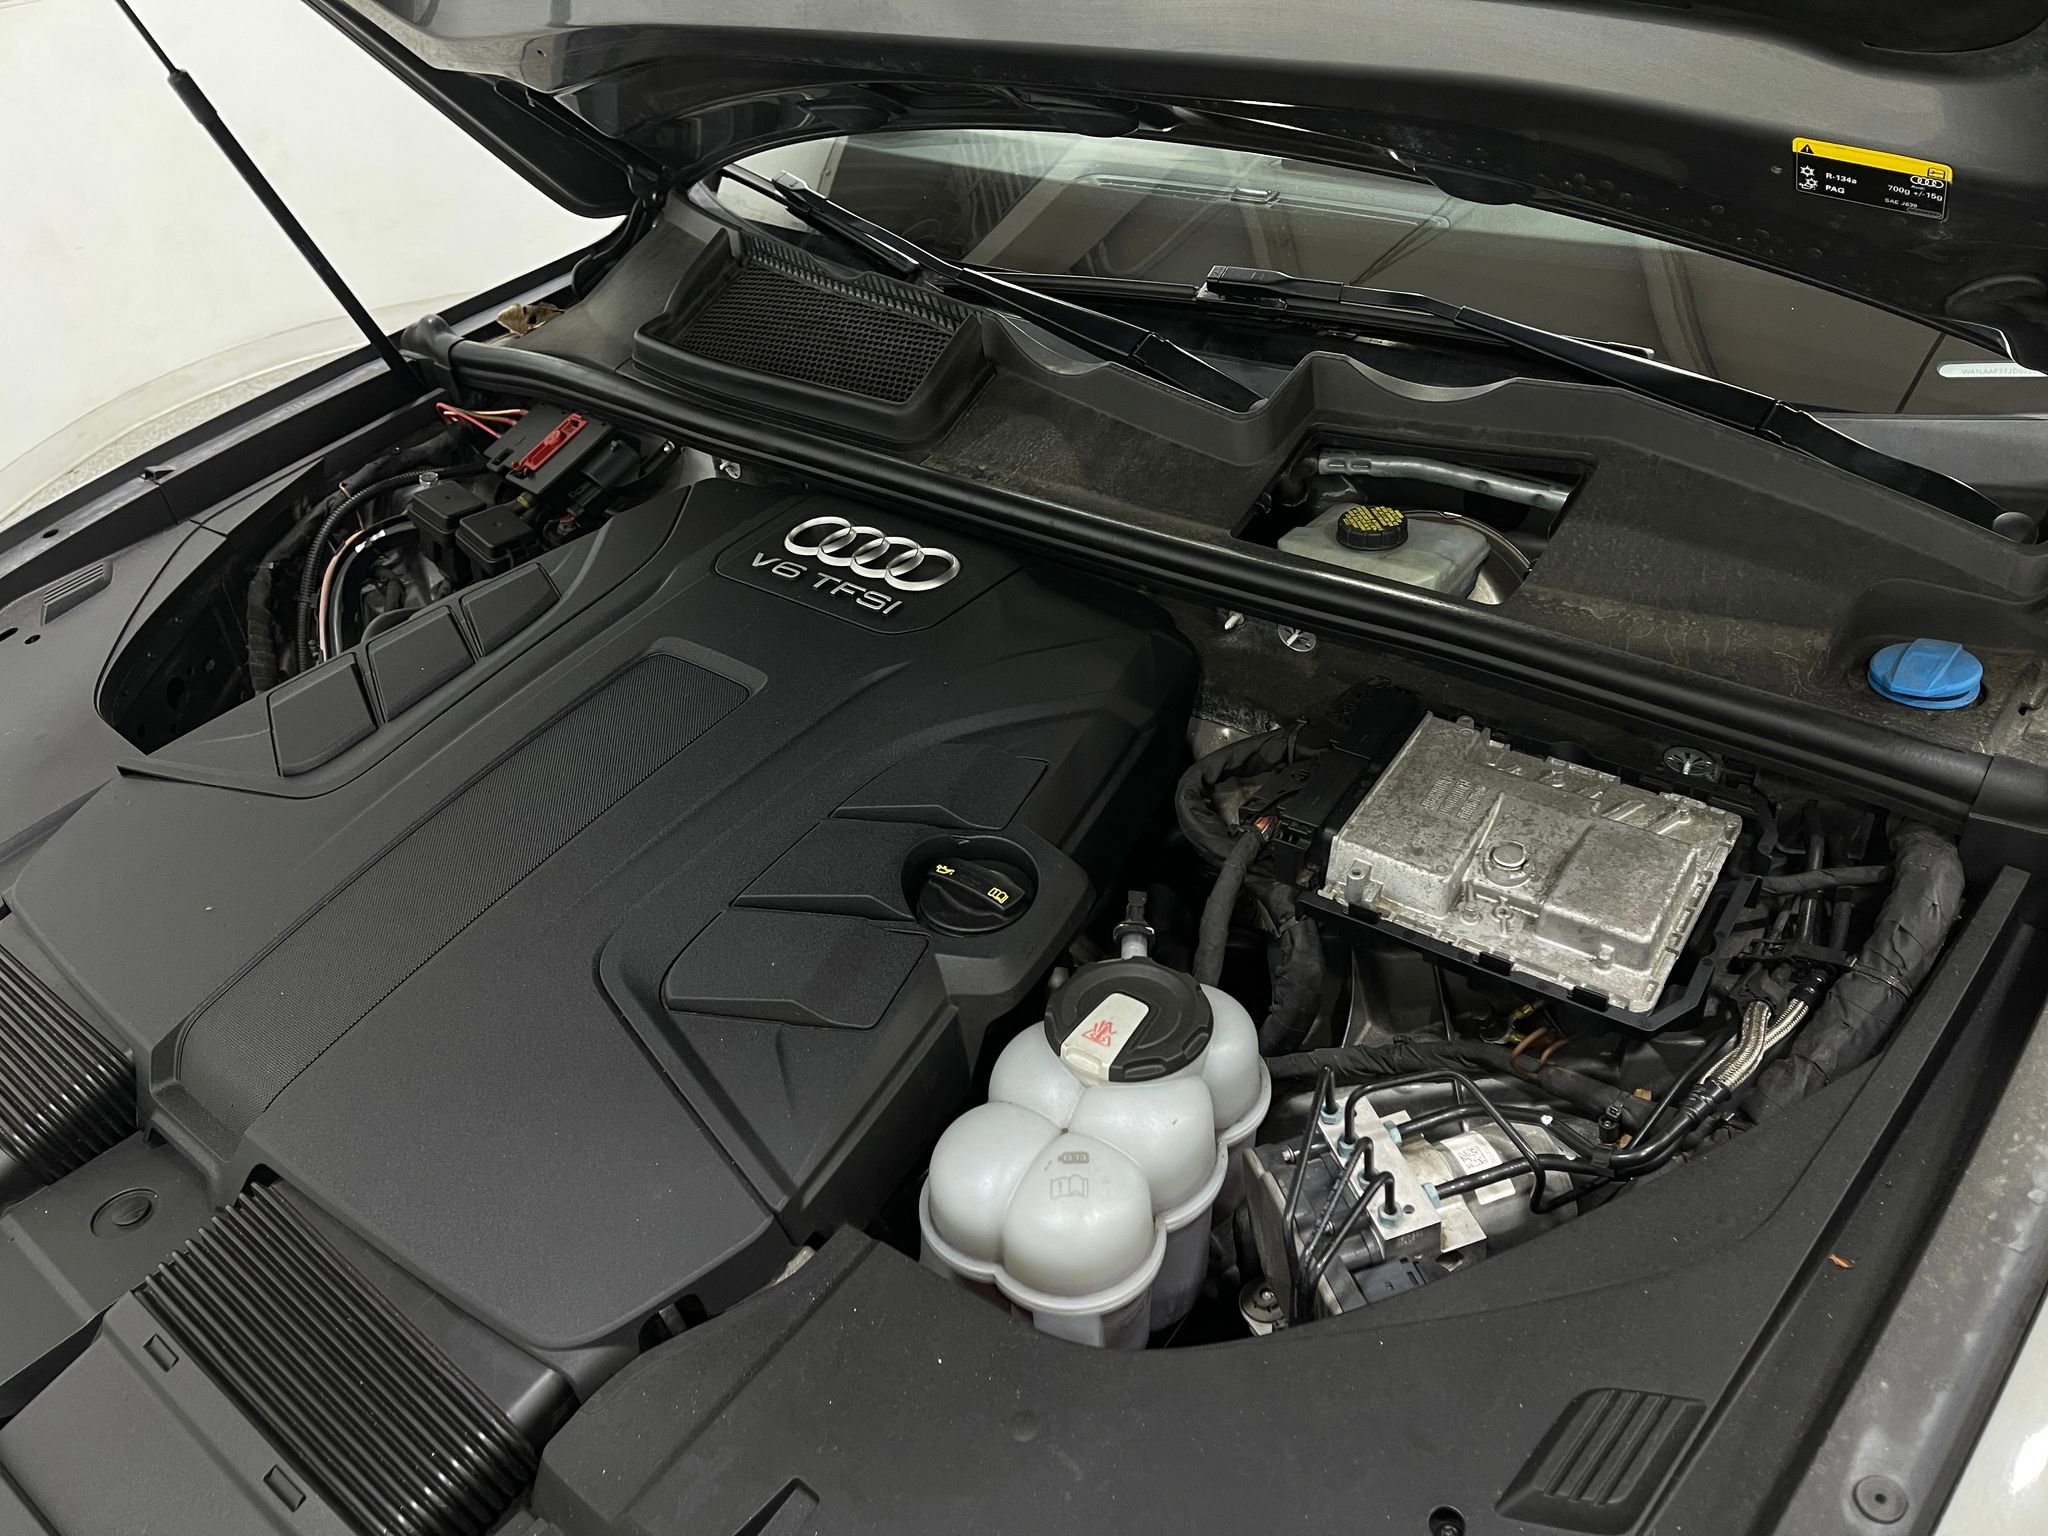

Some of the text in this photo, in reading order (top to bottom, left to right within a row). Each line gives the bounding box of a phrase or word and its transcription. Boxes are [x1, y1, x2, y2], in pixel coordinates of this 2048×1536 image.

[1825, 172, 1857, 184] R-134a
[1825, 184, 1845, 194] PAG
[1887, 184, 1910, 196] 700g
[1884, 197, 1899, 205] SAE
[752, 552, 902, 615] V6 TFSI
